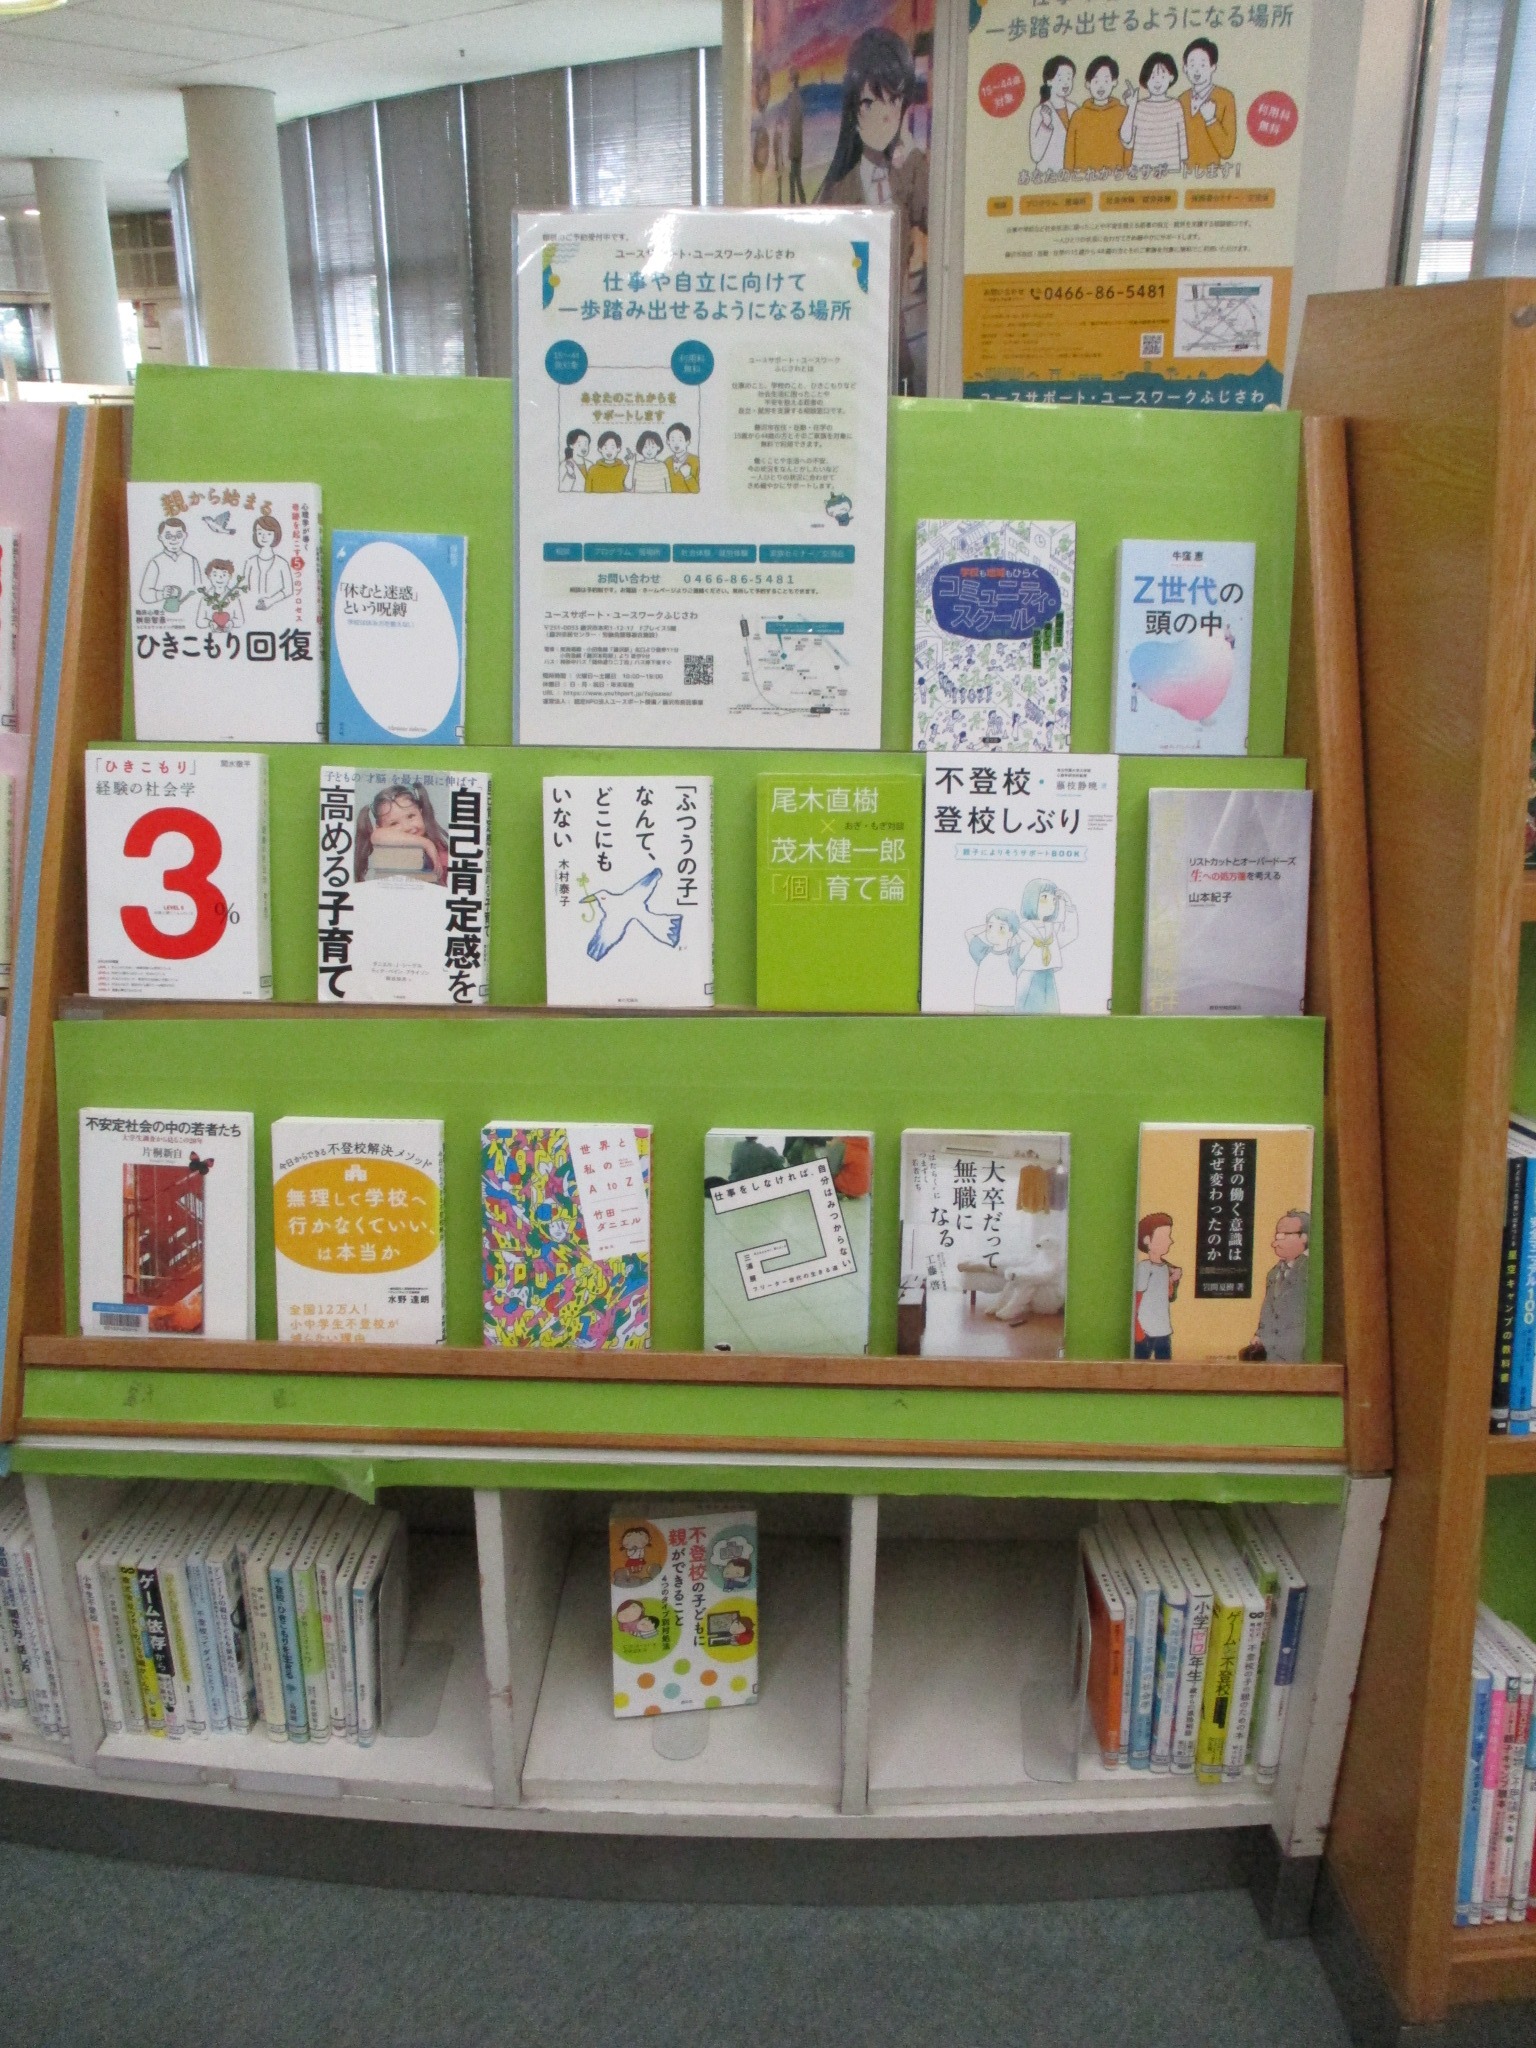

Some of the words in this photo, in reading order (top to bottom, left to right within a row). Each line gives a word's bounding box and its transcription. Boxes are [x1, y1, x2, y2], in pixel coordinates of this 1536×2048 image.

[986, 3, 1294, 41] 一歩踏み出せるようになる場所
[1257, 103, 1291, 123] 利用料
[602, 270, 807, 293] 仕事や自立に向けて
[1043, 284, 1166, 300] 0466-86-5481
[558, 299, 852, 321] 一歩踏み出せるようになる場所
[592, 409, 666, 422] サポートします
[159, 487, 273, 517] 親から始まる
[1172, 550, 1192, 561] 牛窪
[1194, 551, 1205, 562] 恵
[597, 573, 661, 584] お問い合わせ
[339, 582, 419, 602] 「休むと迷惑」
[1133, 575, 1244, 606] Z世代の
[343, 601, 408, 618] という呪縛
[544, 611, 699, 620] ユースサポート・ユースワークふじさわ
[950, 604, 1036, 632] スクール
[1145, 610, 1223, 637] 頭の中
[137, 628, 314, 661] ひきこもり回復
[95, 757, 197, 776] 「ひきこもり」
[95, 781, 196, 798] 経験の社会学
[1056, 780, 1098, 791] 藤枝静暁
[771, 786, 879, 814] 尾木直樹
[552, 788, 573, 848] いない
[635, 785, 656, 861] なんて、
[934, 805, 1081, 835] 登校しぶり
[596, 787, 613, 872] どこにも
[675, 785, 698, 906] 「ふつうの子」
[770, 837, 906, 865] 茂木健一郎
[962, 847, 1081, 859] 親子によりそうサポートBOOK
[1189, 856, 1297, 867] リストカットとオーバードーズ
[558, 859, 570, 907] 木村泰子
[1190, 868, 1281, 882] 生への処方箋を考える
[318, 785, 355, 999] 高める子育て
[771, 873, 906, 903] 「個」育て論
[1188, 891, 1232, 903] 山本紀子
[85, 1116, 242, 1137] 不安定社会の中の若者たち
[142, 1147, 183, 1159] 片桐新自
[278, 1141, 433, 1171] 今日からできる不登校解決メソッド
[580, 1138, 626, 1155] 世界と
[583, 1161, 613, 1175] 私の
[589, 1184, 597, 1194] A
[607, 1182, 618, 1191] to
[626, 1177, 634, 1187] Z
[286, 1187, 428, 1208] 無理して学校へ
[1207, 1142, 1225, 1261] なぜ変わったのか
[1228, 1142, 1245, 1261] 若者の働く意識は
[593, 1208, 615, 1220] 竹田
[597, 1217, 641, 1232] ダニエル
[982, 1160, 1005, 1269] 大卒だって
[317, 1242, 401, 1262] は本当か
[388, 1294, 407, 1304] 水野
[290, 1317, 400, 1330] 小中学生不登校が
[669, 1528, 687, 1627] 親ができること
[688, 1526, 707, 1647] 不登校の子どもに
